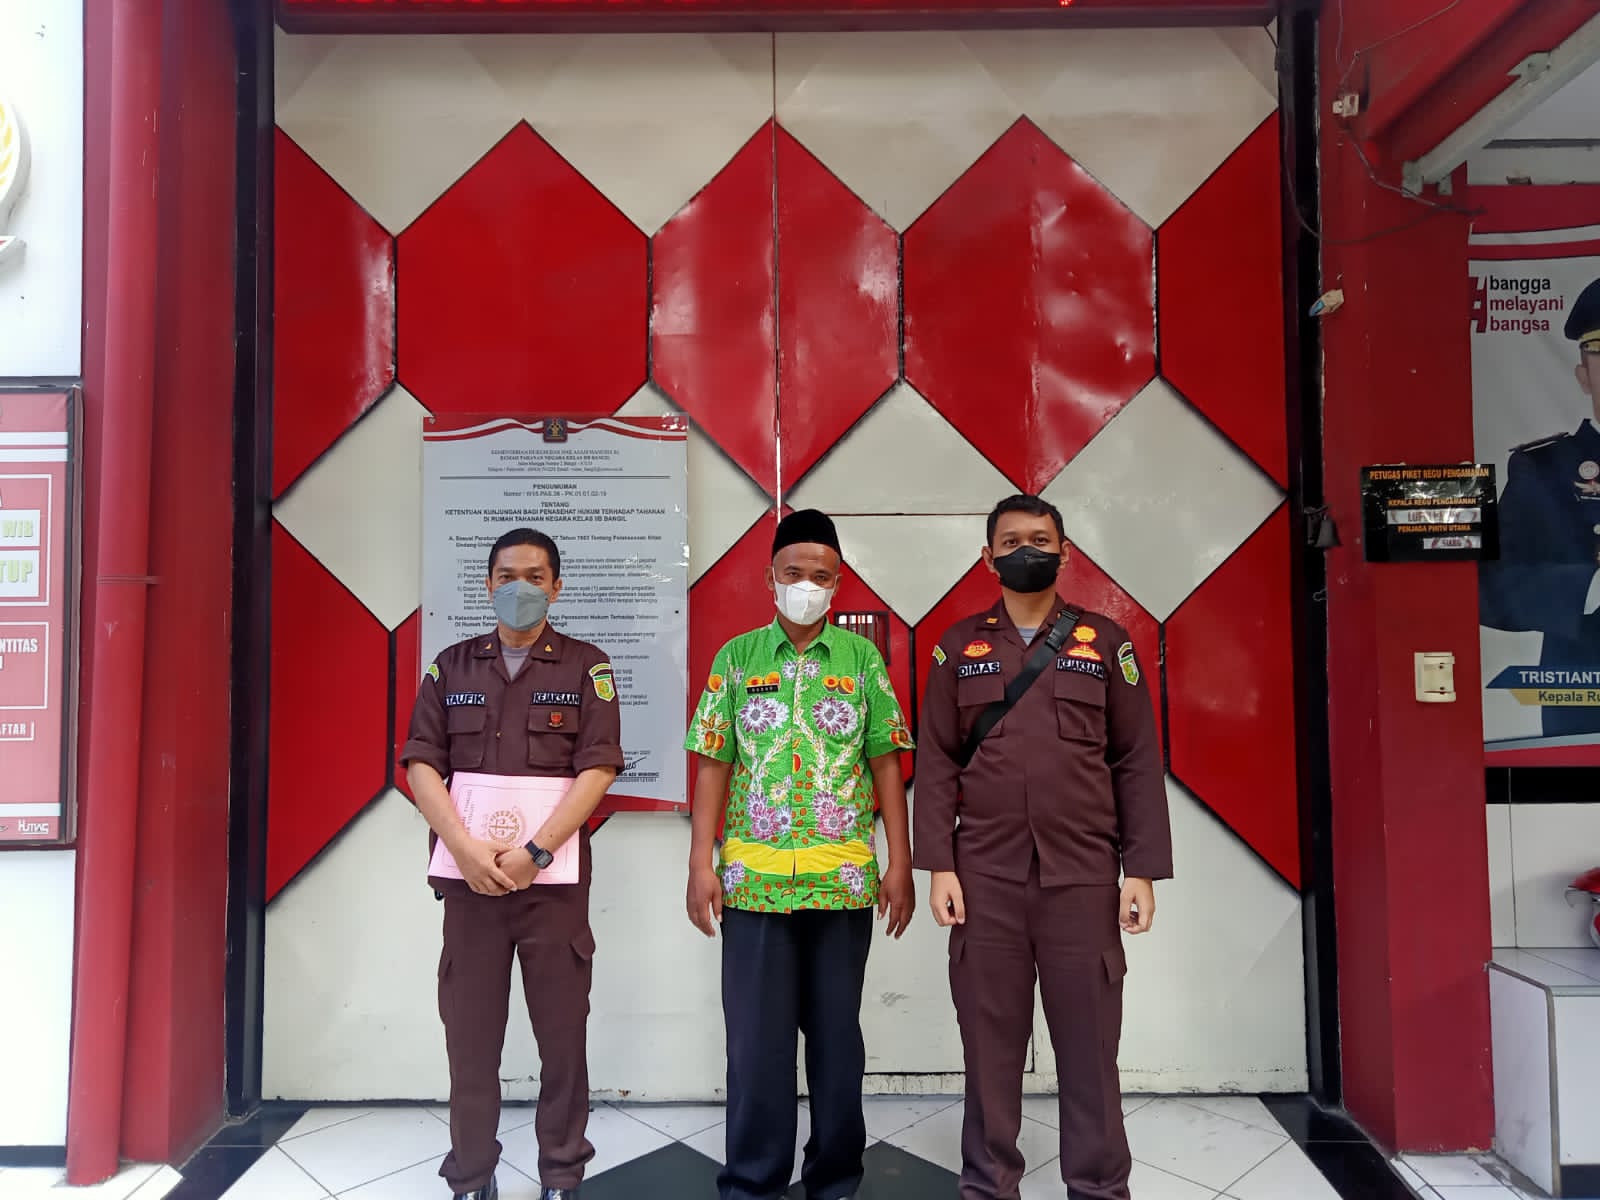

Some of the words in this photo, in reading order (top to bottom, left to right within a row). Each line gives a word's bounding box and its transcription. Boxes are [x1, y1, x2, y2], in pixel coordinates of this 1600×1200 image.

[1490, 275, 1551, 294] bangga
[1490, 296, 1564, 314] melayani
[1490, 315, 1550, 335] bangsa
[1370, 469, 1400, 480] PETUGAS
[1402, 469, 1421, 479] PIKET
[1423, 468, 1441, 479] REGU
[1443, 467, 1489, 478] PENGAMANAN
[1388, 498, 1412, 506] KEPALA
[3, 519, 34, 538] WIB
[958, 661, 1001, 678] DIMAS
[1518, 671, 1600, 684] TRISTIANT
[446, 693, 486, 706] TAUFIK
[532, 692, 581, 705] KEJAKSAAN
[1538, 690, 1583, 704] Kepala
[0, 723, 26, 737] FTAR
